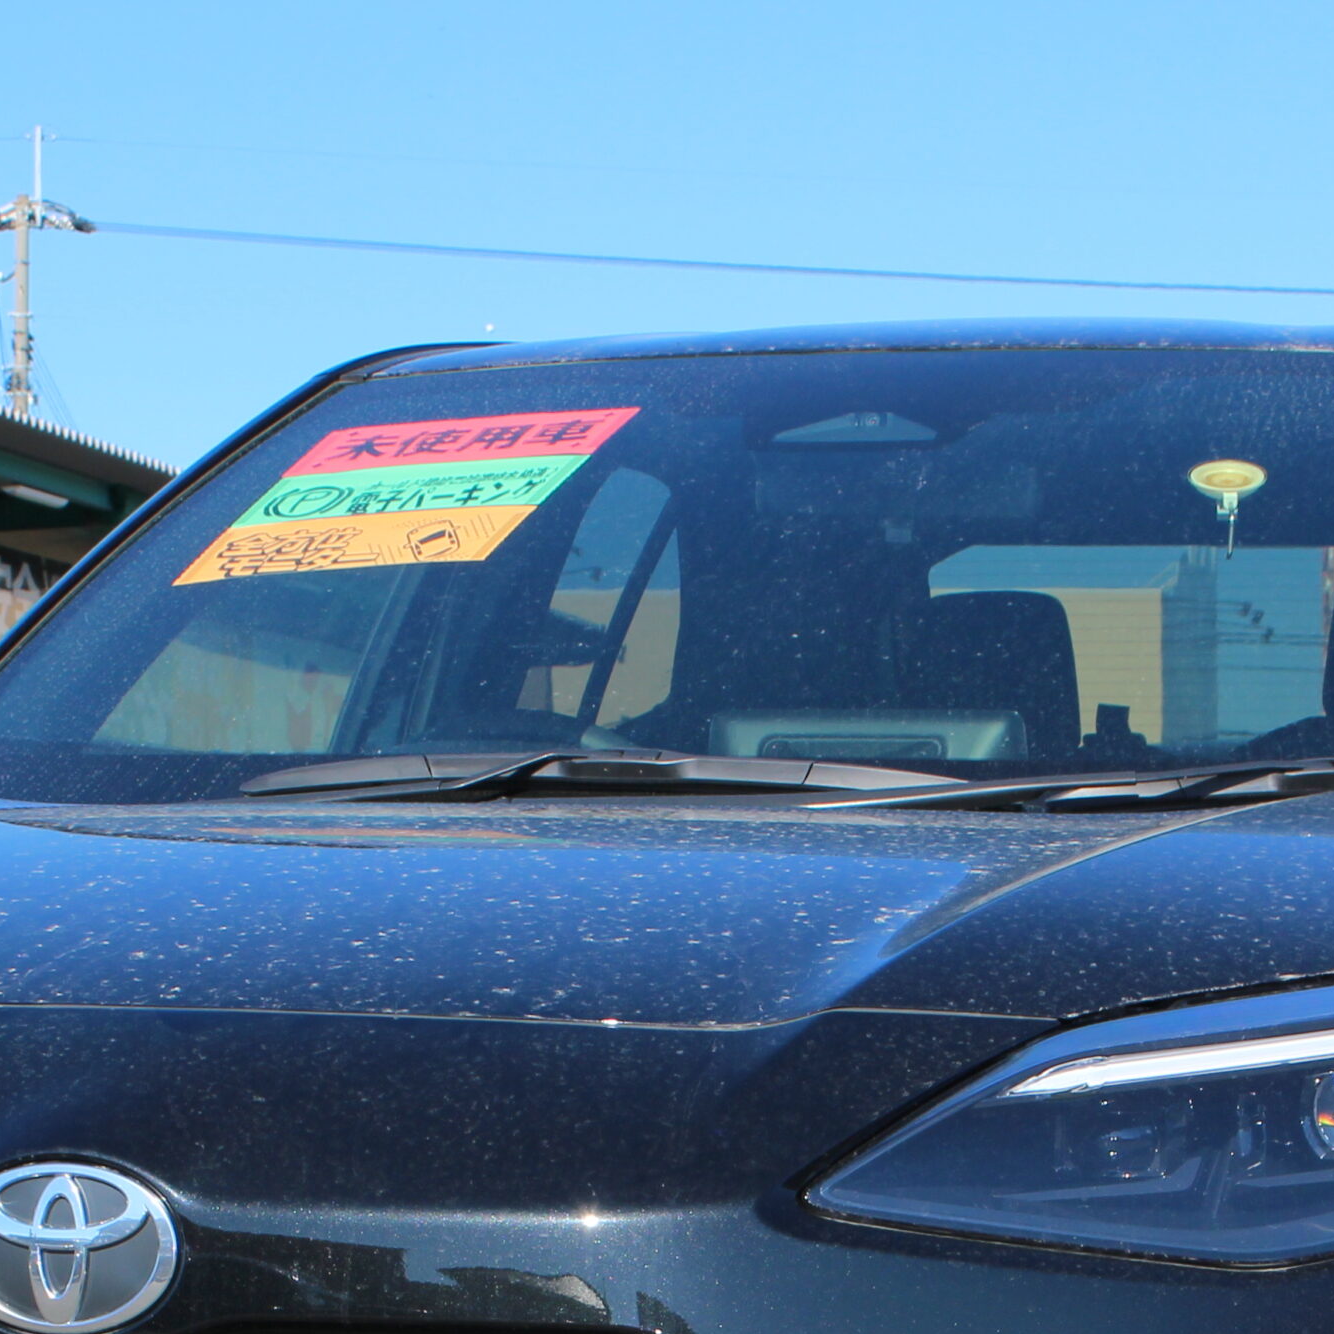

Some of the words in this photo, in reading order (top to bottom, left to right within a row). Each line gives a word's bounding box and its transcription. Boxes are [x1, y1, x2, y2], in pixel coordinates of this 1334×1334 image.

[331, 419, 598, 461] 未使用車
[219, 527, 364, 557] 全方位
[219, 548, 380, 578] モニター
